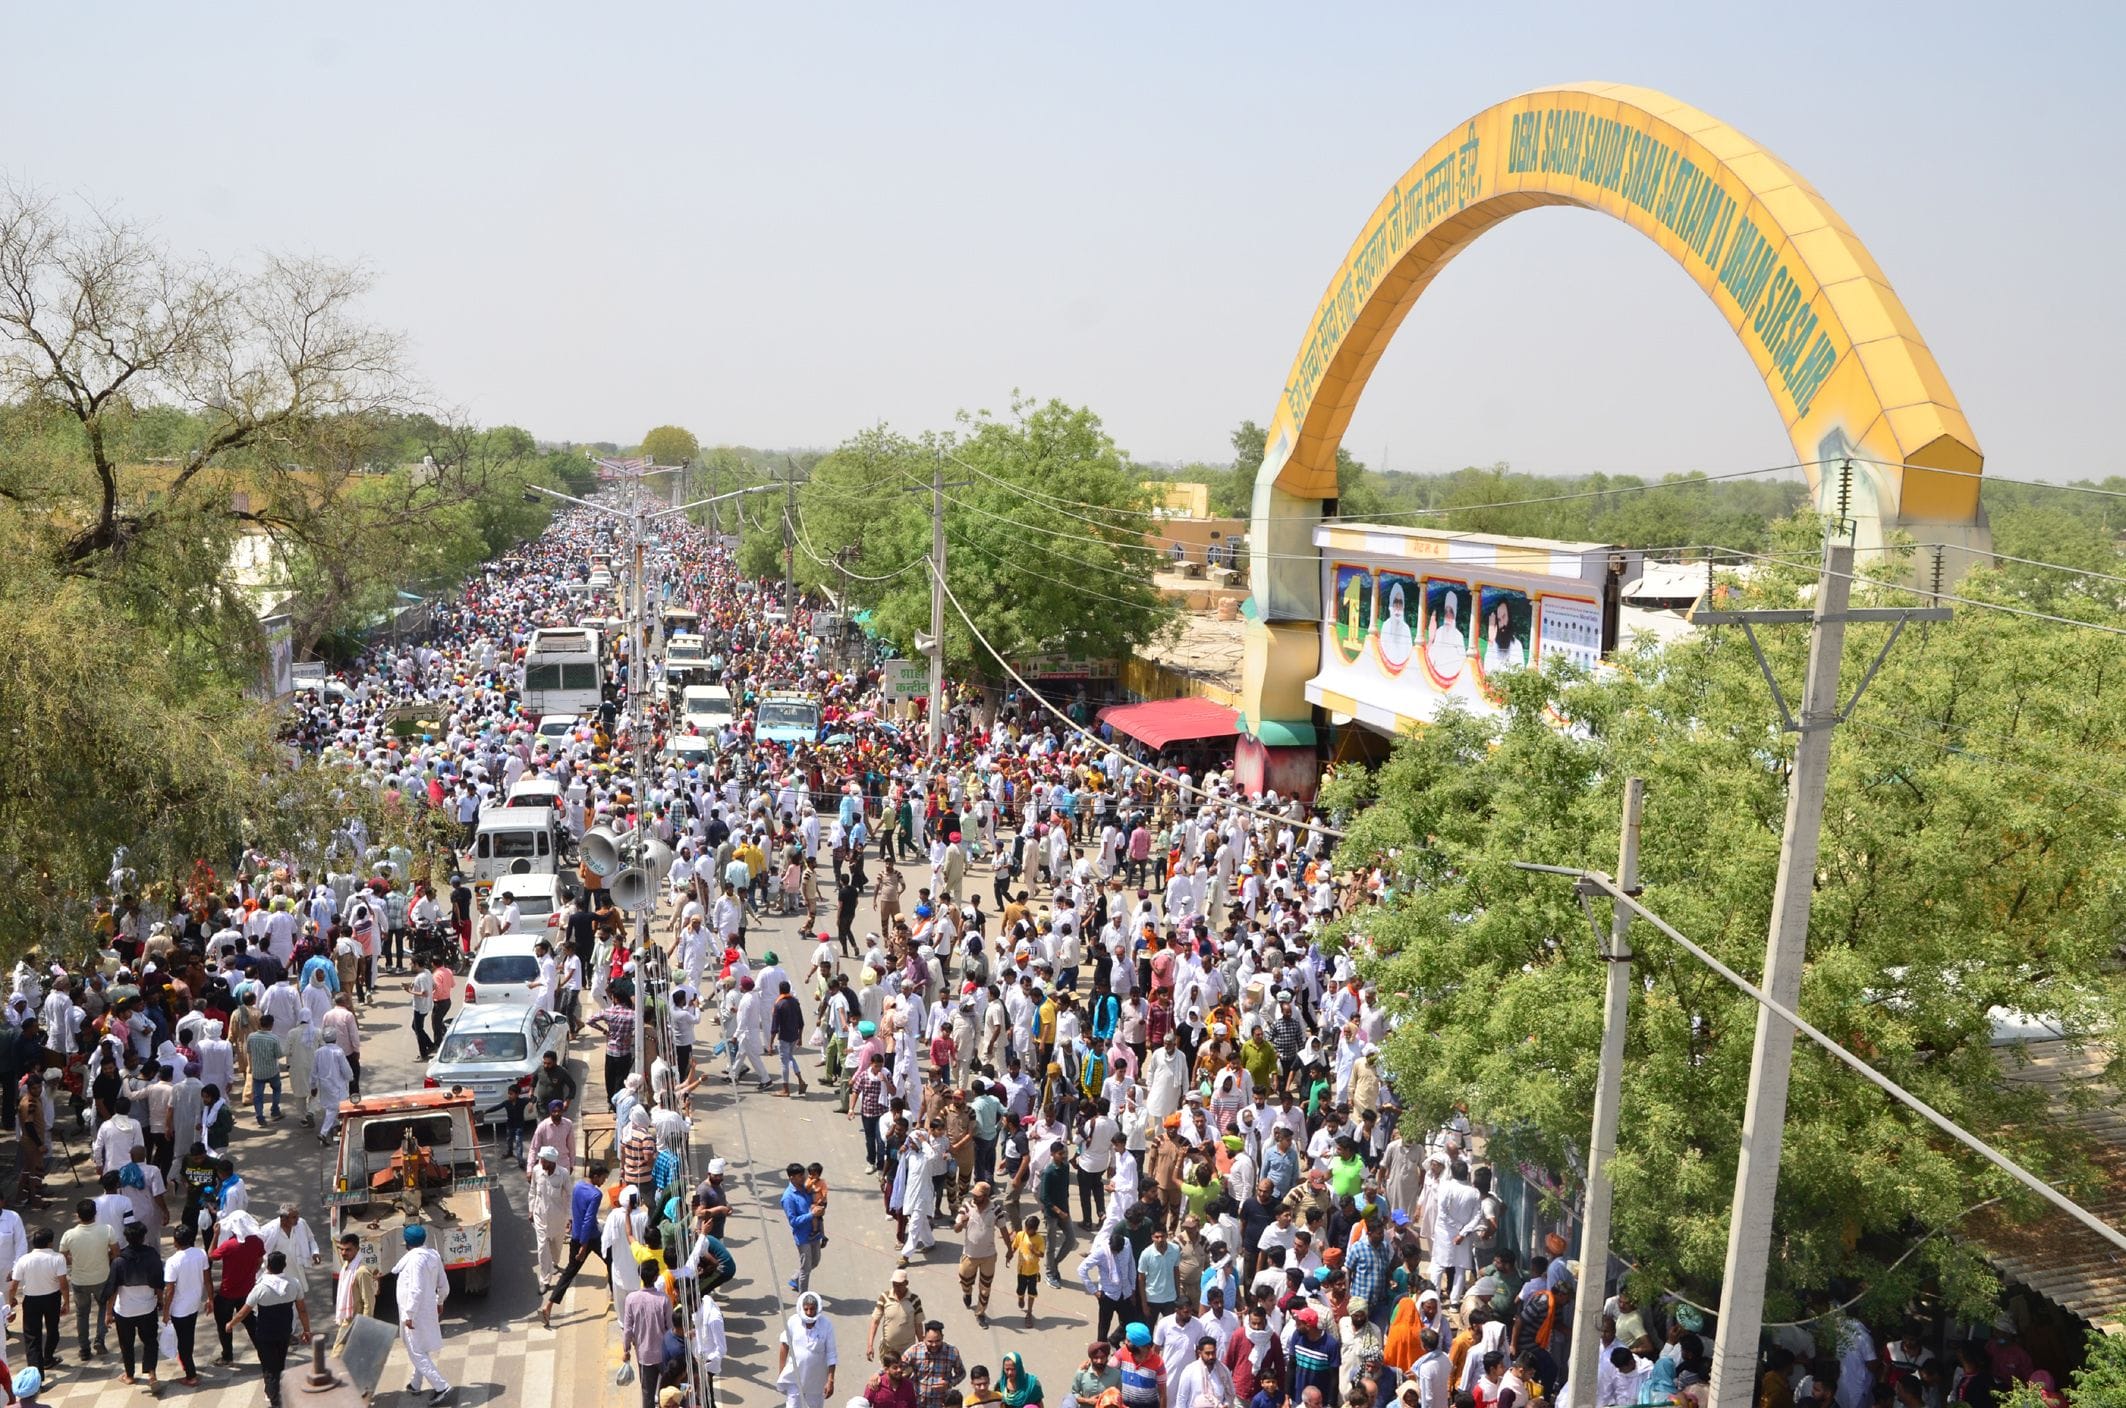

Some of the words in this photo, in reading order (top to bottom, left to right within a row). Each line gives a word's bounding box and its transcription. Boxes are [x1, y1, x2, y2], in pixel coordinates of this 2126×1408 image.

[1508, 110, 1542, 174] DERA
[1541, 108, 1587, 176] SACHA
[1621, 129, 1669, 214] SHAH
[1656, 150, 1725, 258] SATNAM
[456, 1176, 491, 1192] HORN
